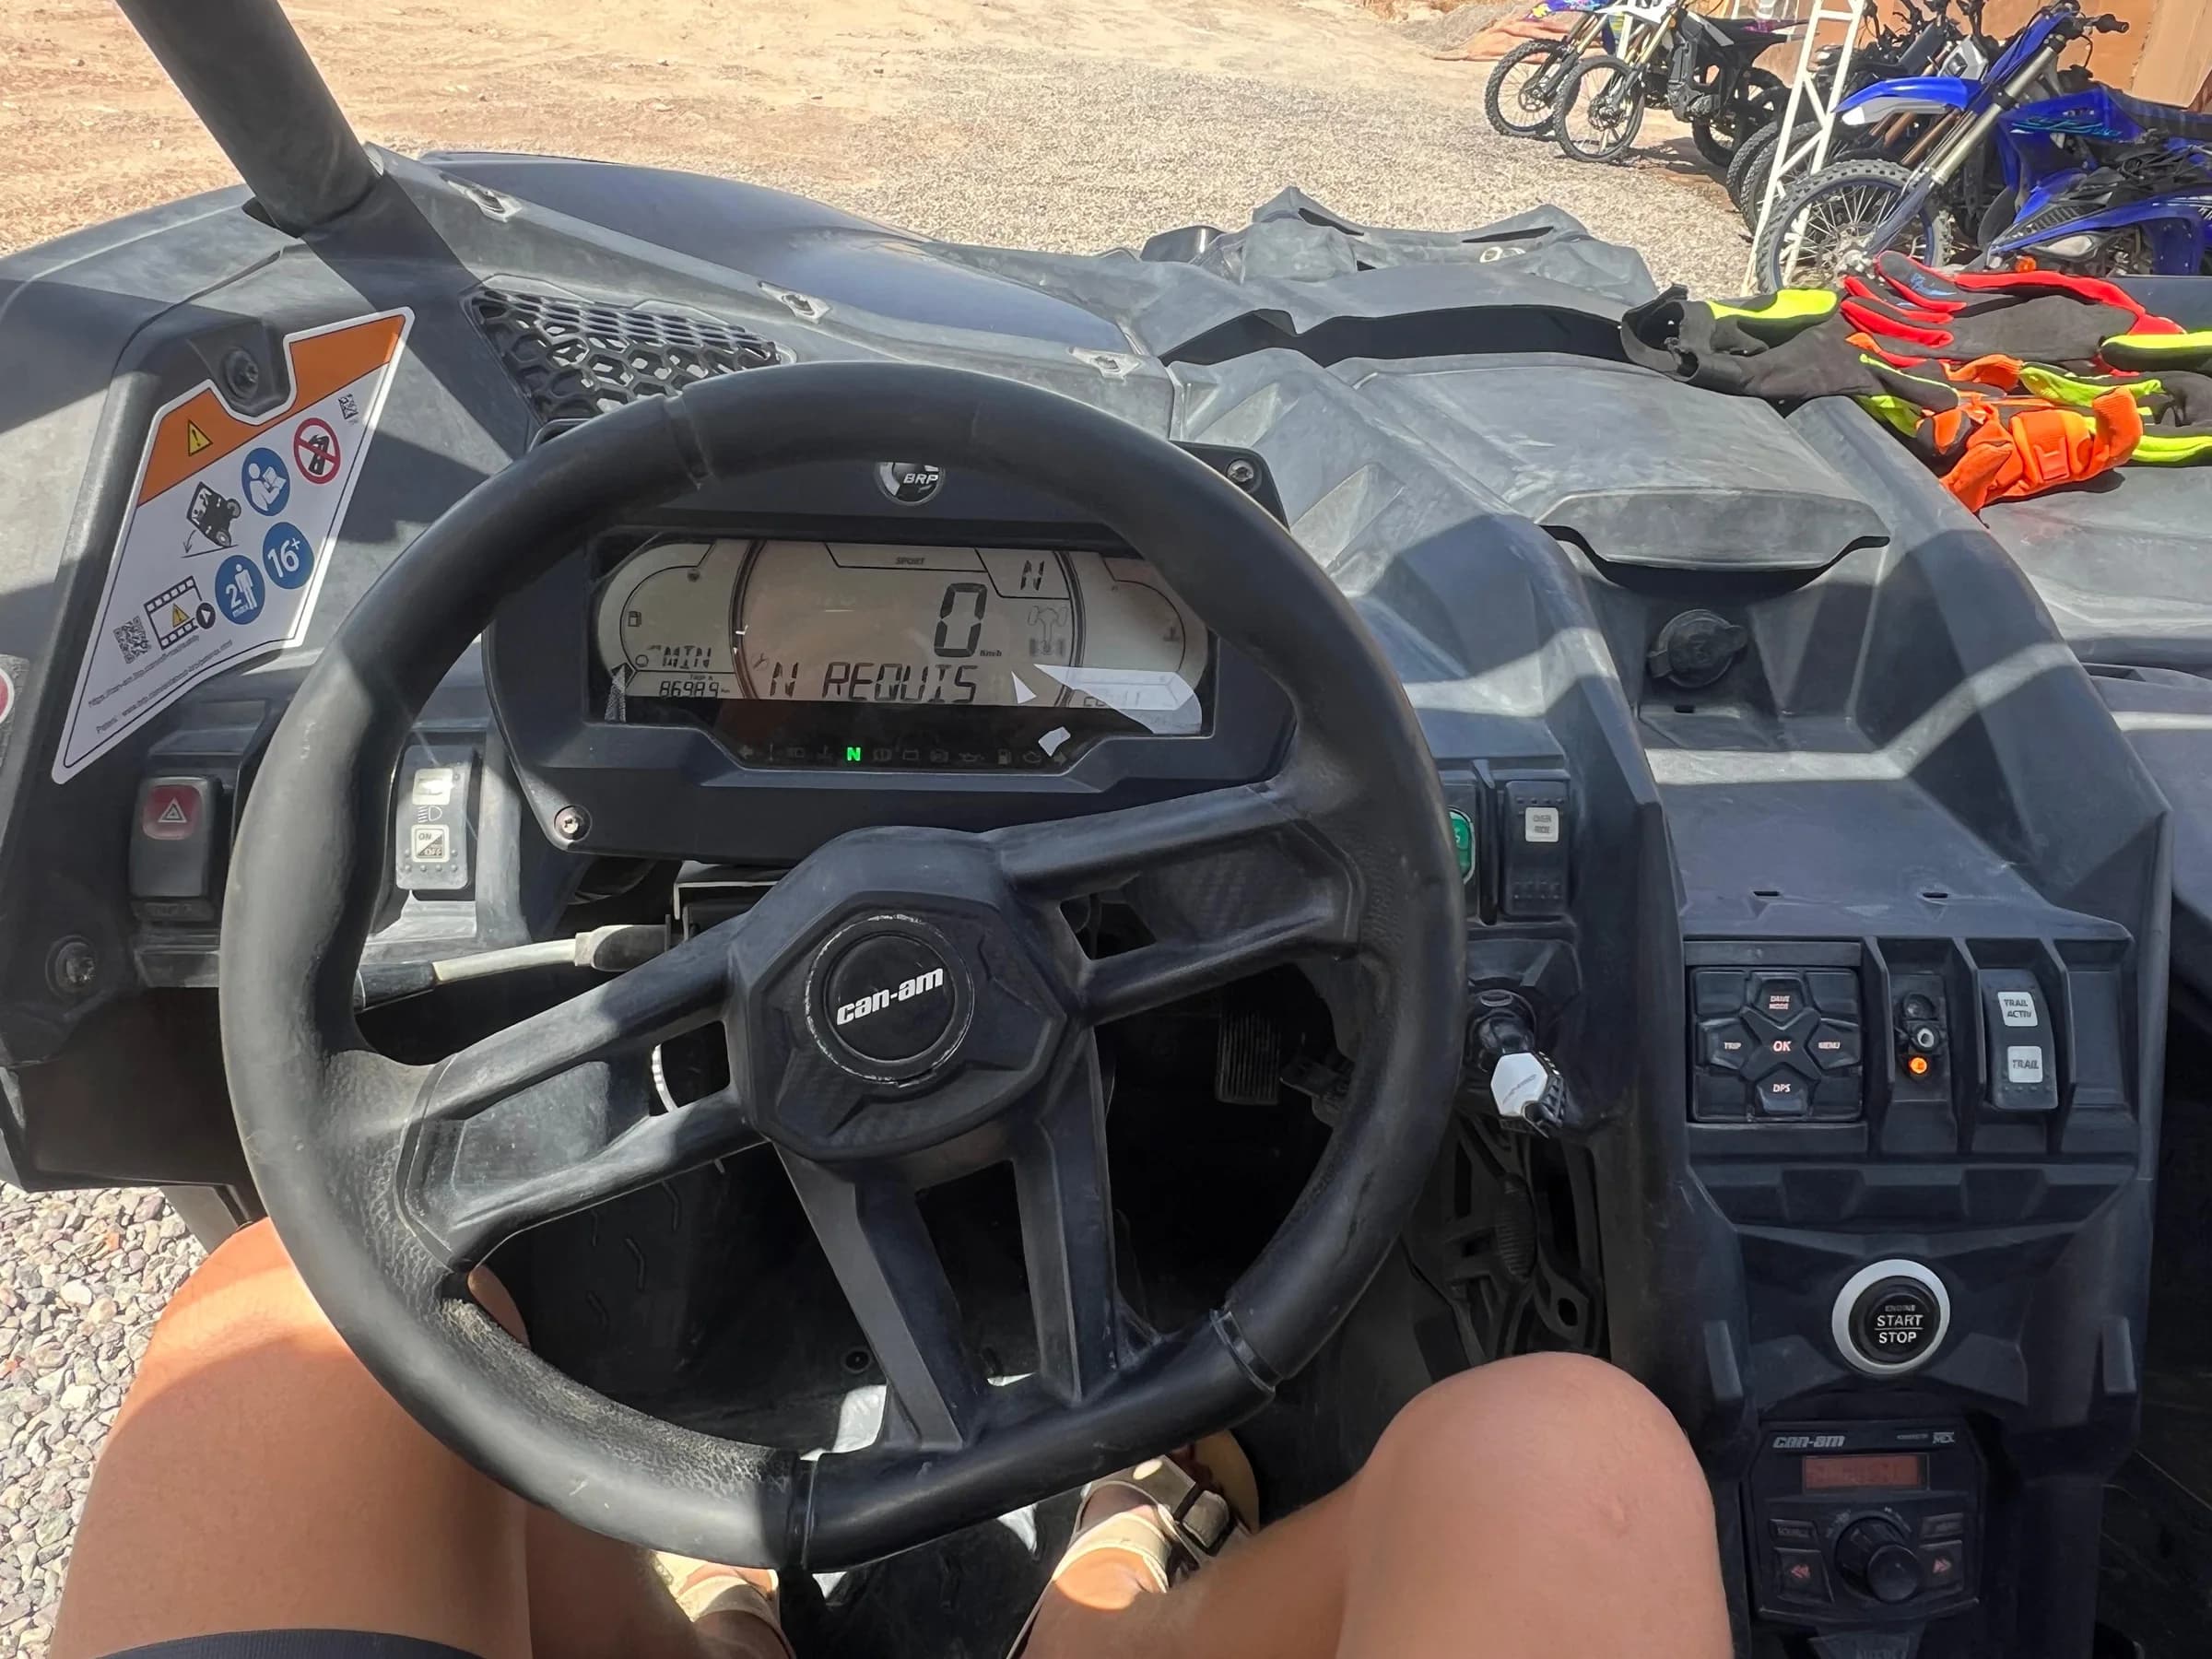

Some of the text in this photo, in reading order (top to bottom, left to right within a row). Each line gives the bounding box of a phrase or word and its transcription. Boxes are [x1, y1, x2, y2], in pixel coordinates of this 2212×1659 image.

[903, 473, 939, 485] BRP
[1020, 560, 1044, 591] N
[226, 583, 242, 609] 2
[934, 582, 987, 657] 0
[770, 662, 978, 703] N REQUIS
[847, 747, 862, 761] N
[424, 848, 441, 856] OFF
[837, 968, 943, 1025] can-am
[1772, 1041, 1792, 1052] OK
[2012, 1059, 2040, 1069] TRAIL
[1772, 1084, 1791, 1092] DPS
[1877, 1314, 1924, 1327] START
[1878, 1331, 1917, 1344] STOP
